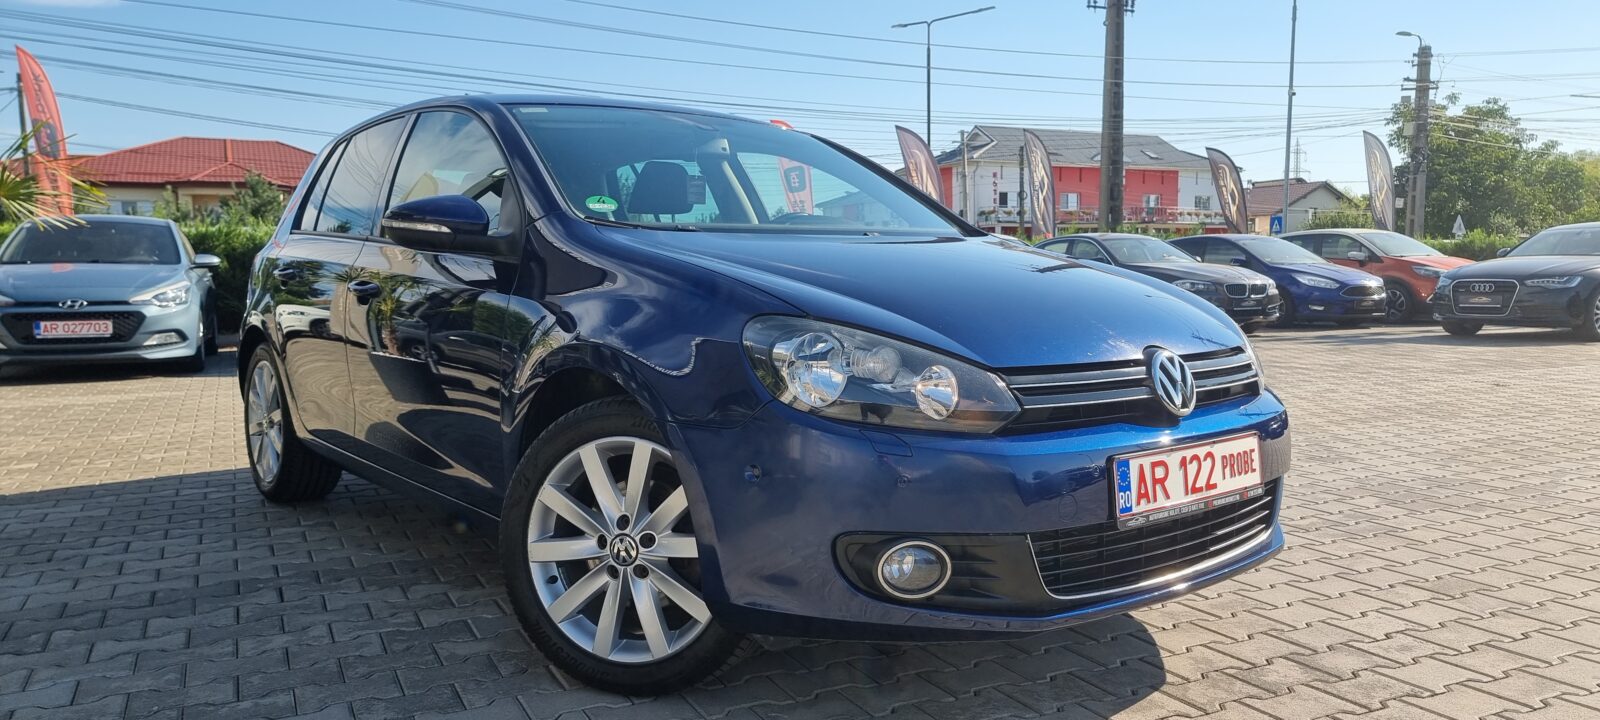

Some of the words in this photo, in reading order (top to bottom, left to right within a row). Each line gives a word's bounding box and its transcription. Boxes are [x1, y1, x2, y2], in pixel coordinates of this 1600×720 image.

[42, 323, 59, 334] AR
[62, 322, 109, 334] 027703
[1136, 459, 1170, 506] AR
[1179, 451, 1218, 496] 122
[1221, 448, 1257, 481] PROBE
[1119, 490, 1132, 510] RO
